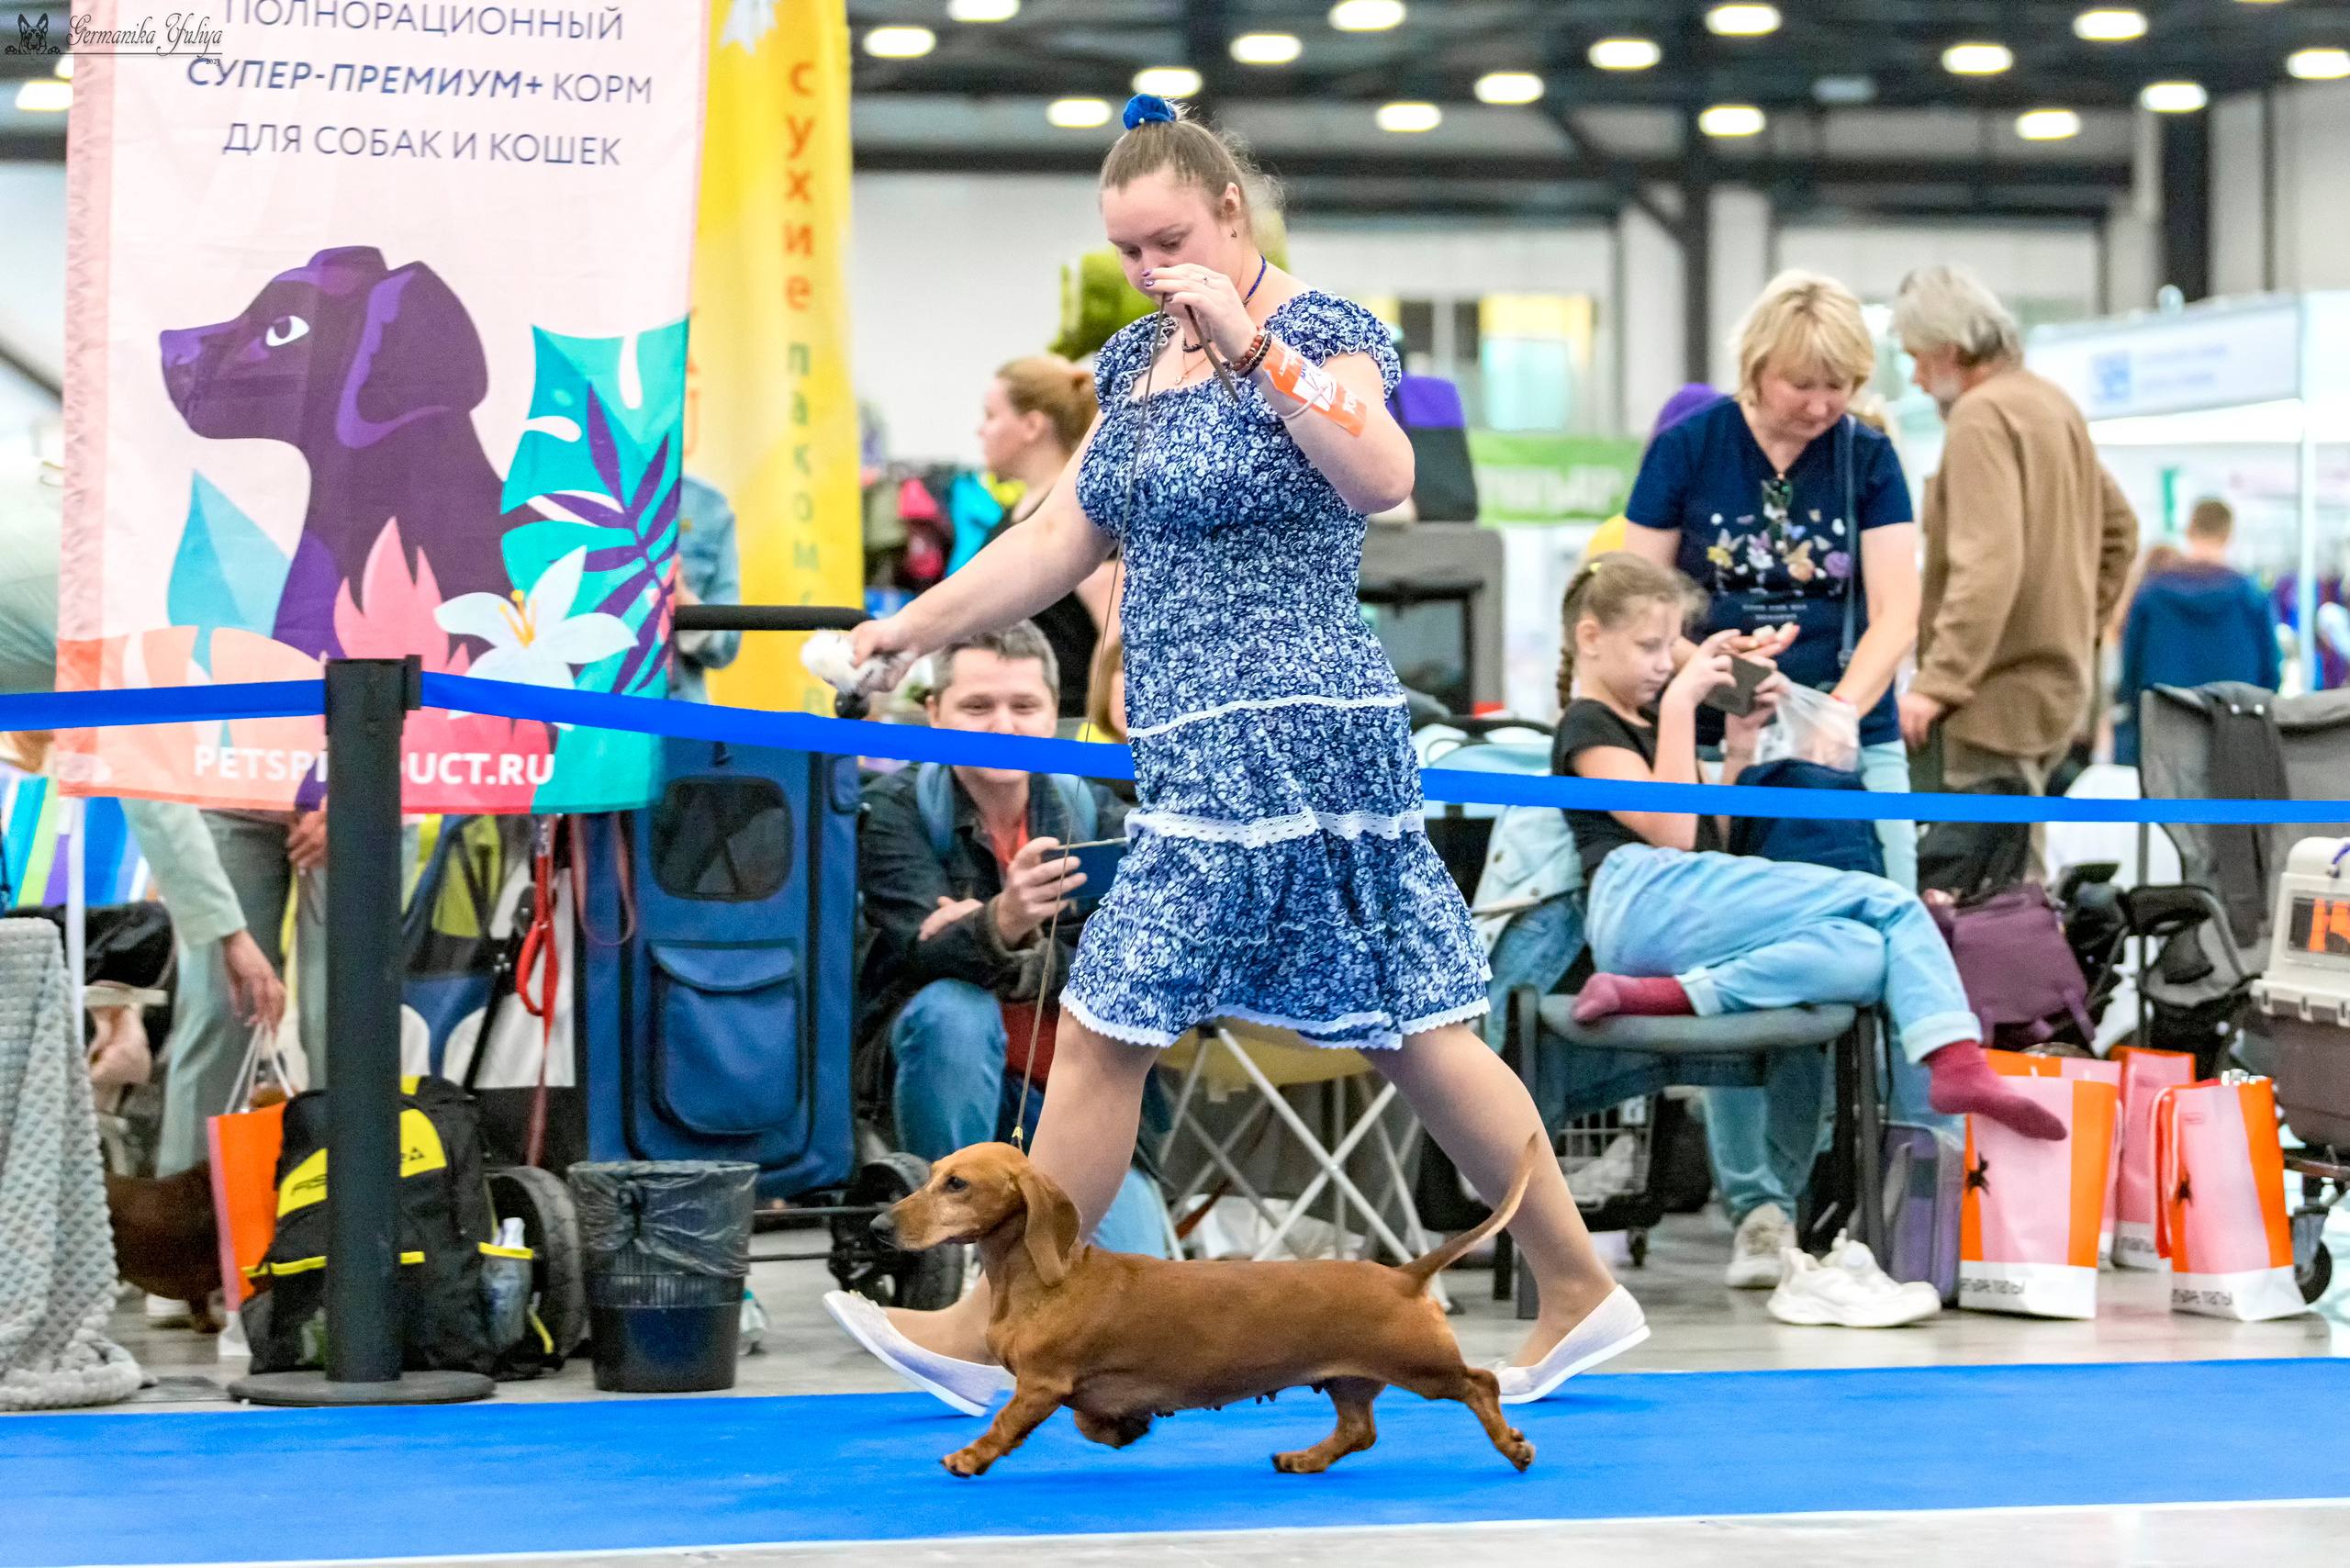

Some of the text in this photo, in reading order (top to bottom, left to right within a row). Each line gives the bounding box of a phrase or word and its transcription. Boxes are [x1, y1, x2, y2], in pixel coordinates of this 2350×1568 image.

[226, 0, 623, 40] ПОЛНОРАЦИОННЫЙ
[187, 57, 653, 105] СУПЕР-ПРЕМИУМ+ КОРМ
[222, 123, 621, 166] ДЛЯ СОБАК И КОШЕК
[194, 745, 554, 785] PETSPUCT.RU
